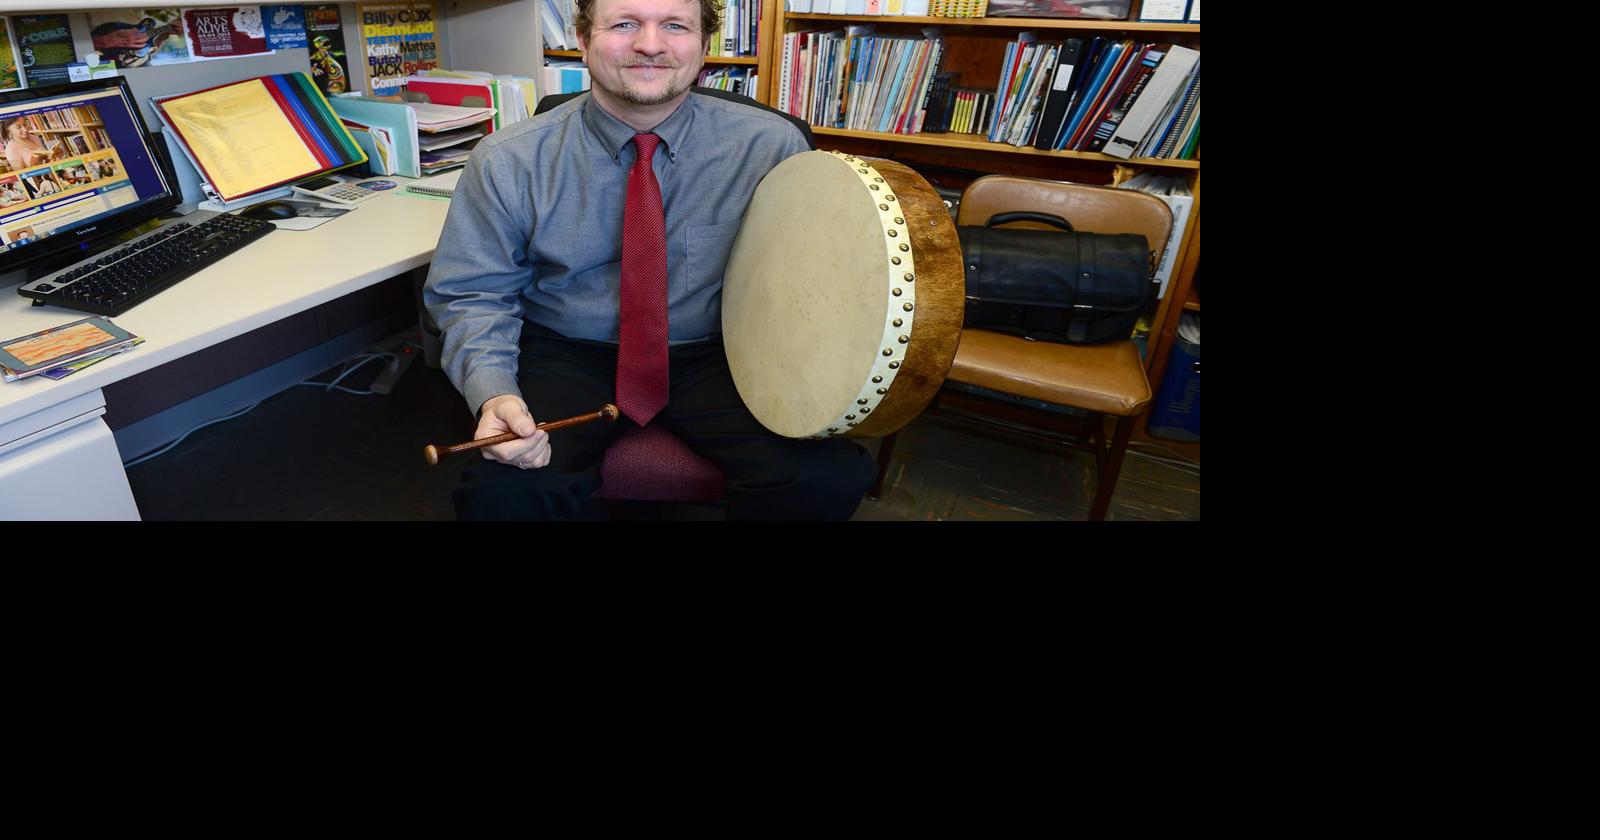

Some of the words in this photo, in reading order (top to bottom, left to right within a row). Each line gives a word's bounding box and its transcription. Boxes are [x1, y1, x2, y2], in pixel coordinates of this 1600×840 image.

[196, 15, 228, 26] ARTS
[363, 11, 397, 26] Billy
[197, 24, 229, 34] ALIVE
[364, 21, 434, 37] Diamond
[367, 43, 400, 57] Kathy
[400, 41, 436, 53] Mattea
[368, 54, 402, 66] Butch
[370, 64, 403, 77] JACK
[403, 61, 438, 73] Rollins
[371, 75, 409, 90] Connie
